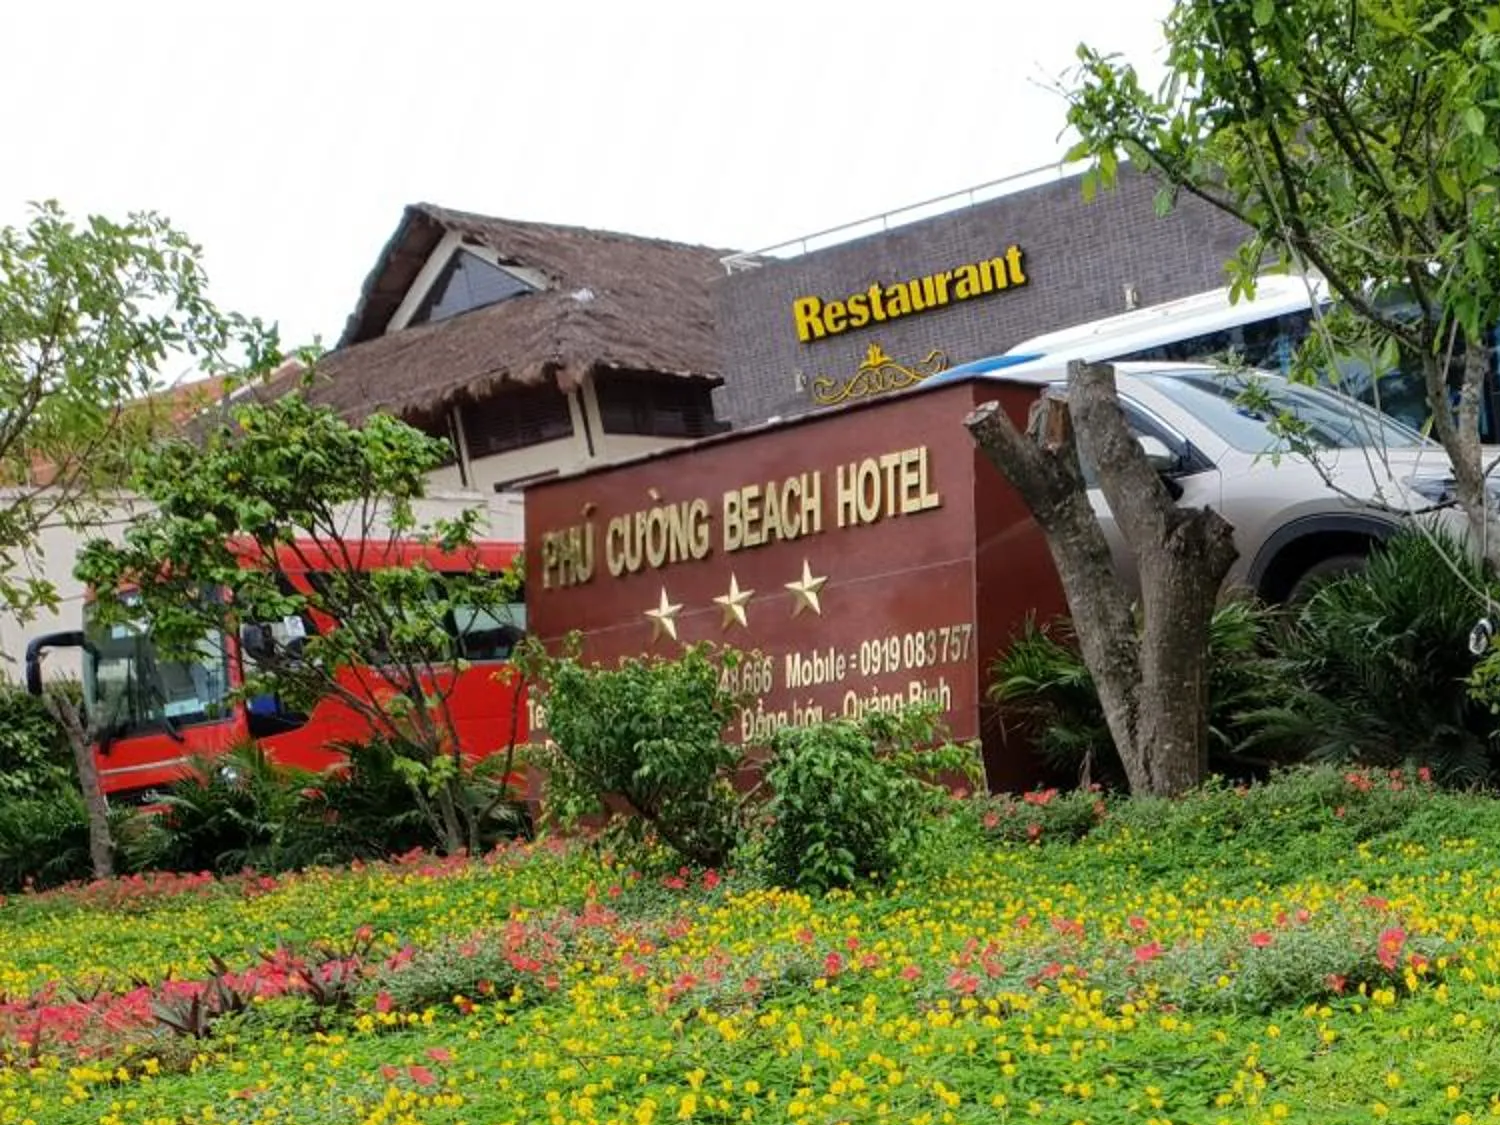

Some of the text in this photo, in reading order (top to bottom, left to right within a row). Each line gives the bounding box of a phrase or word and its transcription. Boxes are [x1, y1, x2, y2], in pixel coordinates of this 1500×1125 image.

[793, 244, 1028, 343] Restaurant
[722, 470, 822, 553] BEACH
[836, 445, 941, 529] HOTEL
